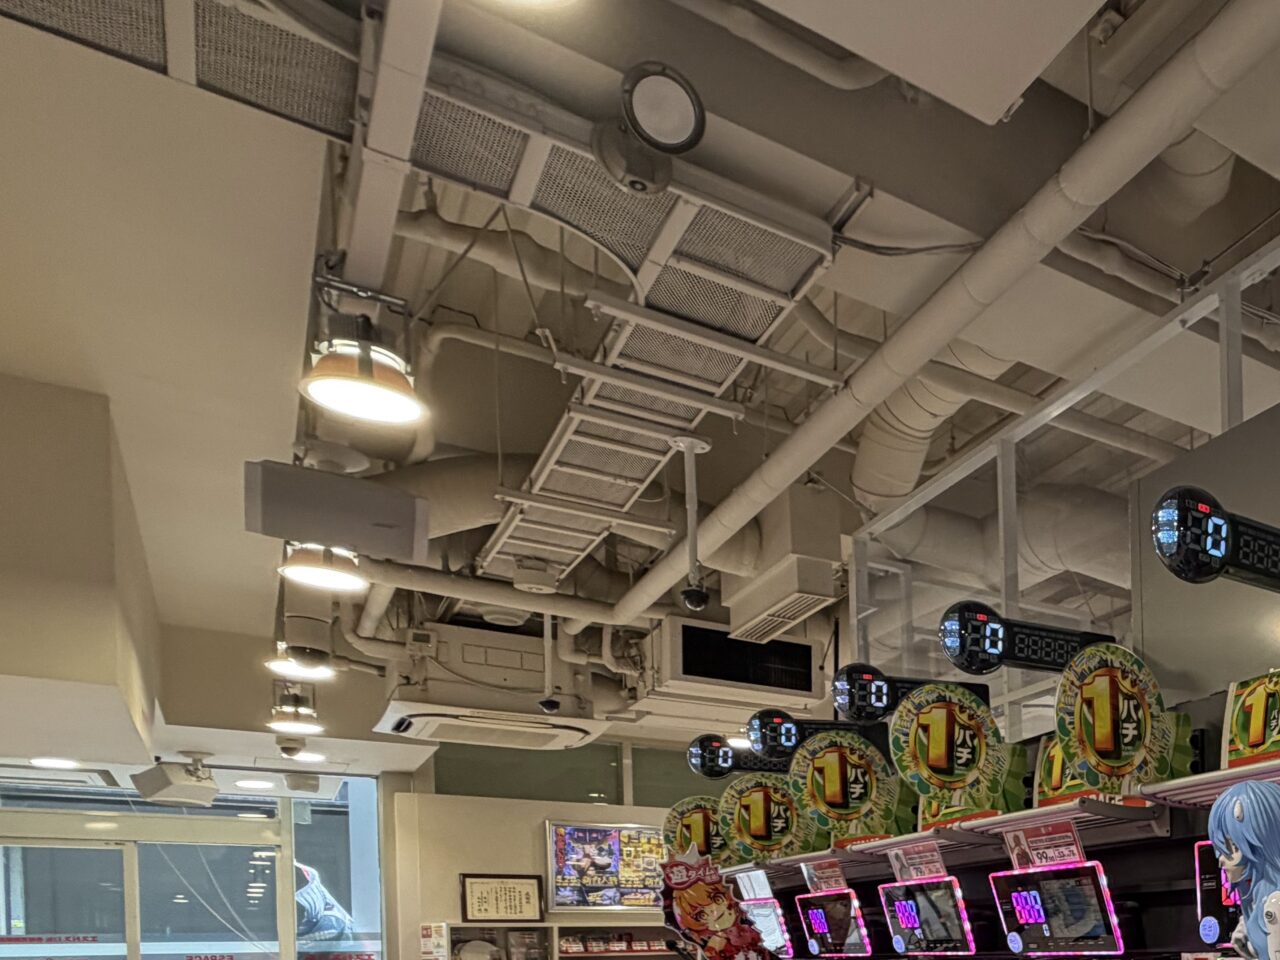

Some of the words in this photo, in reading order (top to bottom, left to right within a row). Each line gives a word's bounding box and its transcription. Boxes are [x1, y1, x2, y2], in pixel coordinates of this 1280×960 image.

[1206, 515, 1228, 558] 0
[984, 622, 1004, 654] 0
[870, 680, 889, 708] 0
[1081, 674, 1116, 752] 1
[1121, 697, 1143, 744] パチ
[780, 722, 797, 747] 0
[917, 707, 949, 769] 1
[955, 728, 978, 764] パチ
[718, 746, 733, 768] 0
[812, 750, 843, 804] 1
[848, 767, 869, 798] パチ
[739, 790, 766, 837] 1
[771, 802, 789, 831] パチ
